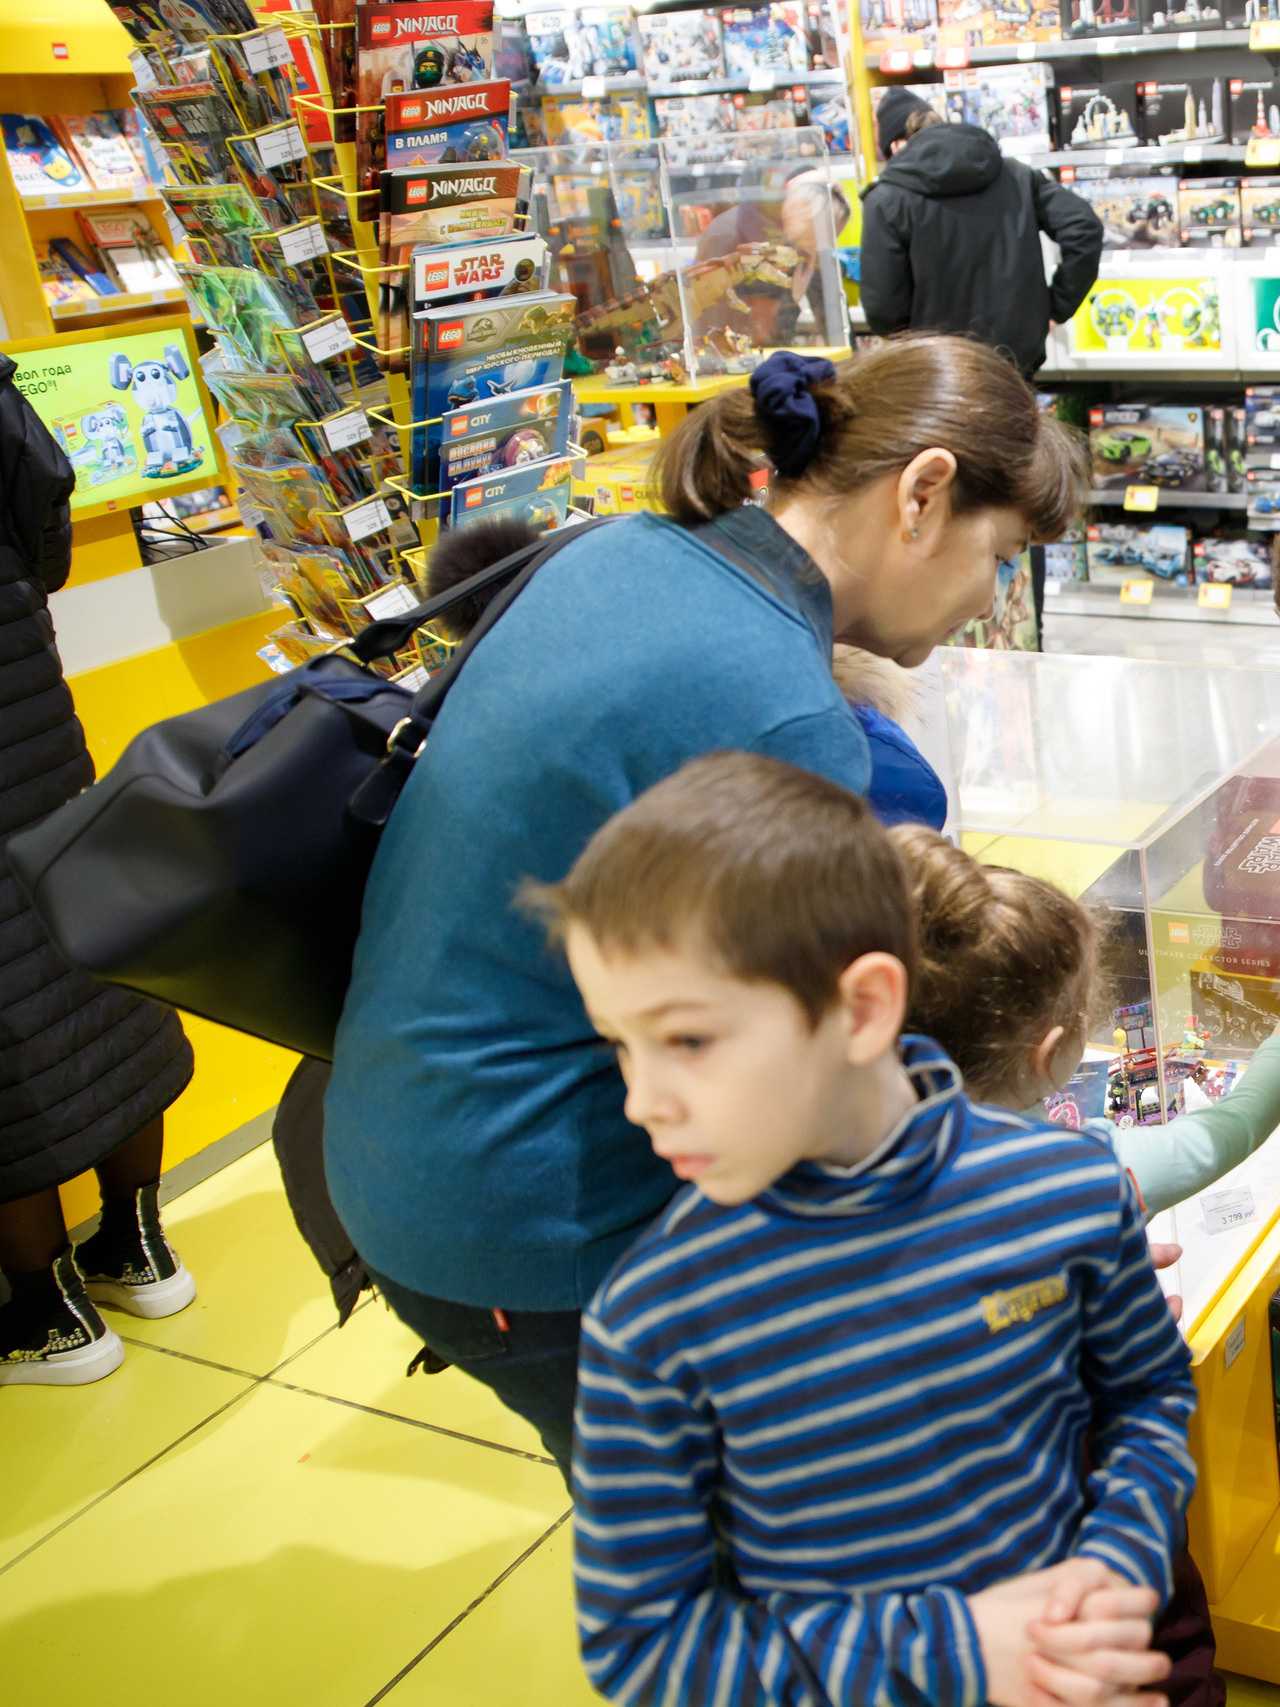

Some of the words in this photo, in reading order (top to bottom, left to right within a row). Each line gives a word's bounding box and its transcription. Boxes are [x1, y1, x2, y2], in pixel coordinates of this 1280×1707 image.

[372, 22, 391, 34] LEGO
[394, 15, 460, 38] NINJAGO
[401, 106, 421, 118] LEGO
[424, 93, 489, 121] NINJAGO
[395, 138, 404, 149] В
[407, 132, 448, 148] ПЛАМЯ
[280, 150, 291, 159] 329
[408, 187, 427, 198] LEGO
[429, 177, 498, 201] NINJAGO
[460, 208, 489, 219] КНИГА
[440, 225, 446, 235] С
[447, 217, 508, 233] НАКЛЕЙКАМИ
[302, 247, 313, 256] 329
[427, 269, 448, 283] LEGO
[453, 253, 505, 273] STAR
[454, 266, 505, 286] WARS
[439, 329, 462, 343] LEGO
[328, 342, 339, 351] 329
[486, 340, 562, 361] НЕОБЫКНОВЕННЫЙ
[465, 365, 482, 375] МИР
[483, 356, 520, 370] ЮРСКОГО
[521, 348, 561, 361] ПЕРИОДА!
[12, 370, 39, 382] вол
[42, 365, 72, 377] года
[470, 413, 492, 427] CITY
[449, 437, 496, 461] ПОСАДКА
[448, 462, 462, 477] НА
[485, 484, 507, 499] CITY
[1238, 836, 1280, 873] WARS
[1170, 927, 1188, 937] LEGO
[1192, 924, 1241, 938] STAR
[1193, 935, 1241, 949] WARS
[1138, 949, 1185, 958] ULTIMATE
[1187, 953, 1238, 964] COLLECTOR
[1241, 959, 1271, 967] SERIES
[1228, 1212, 1243, 1222] 799
